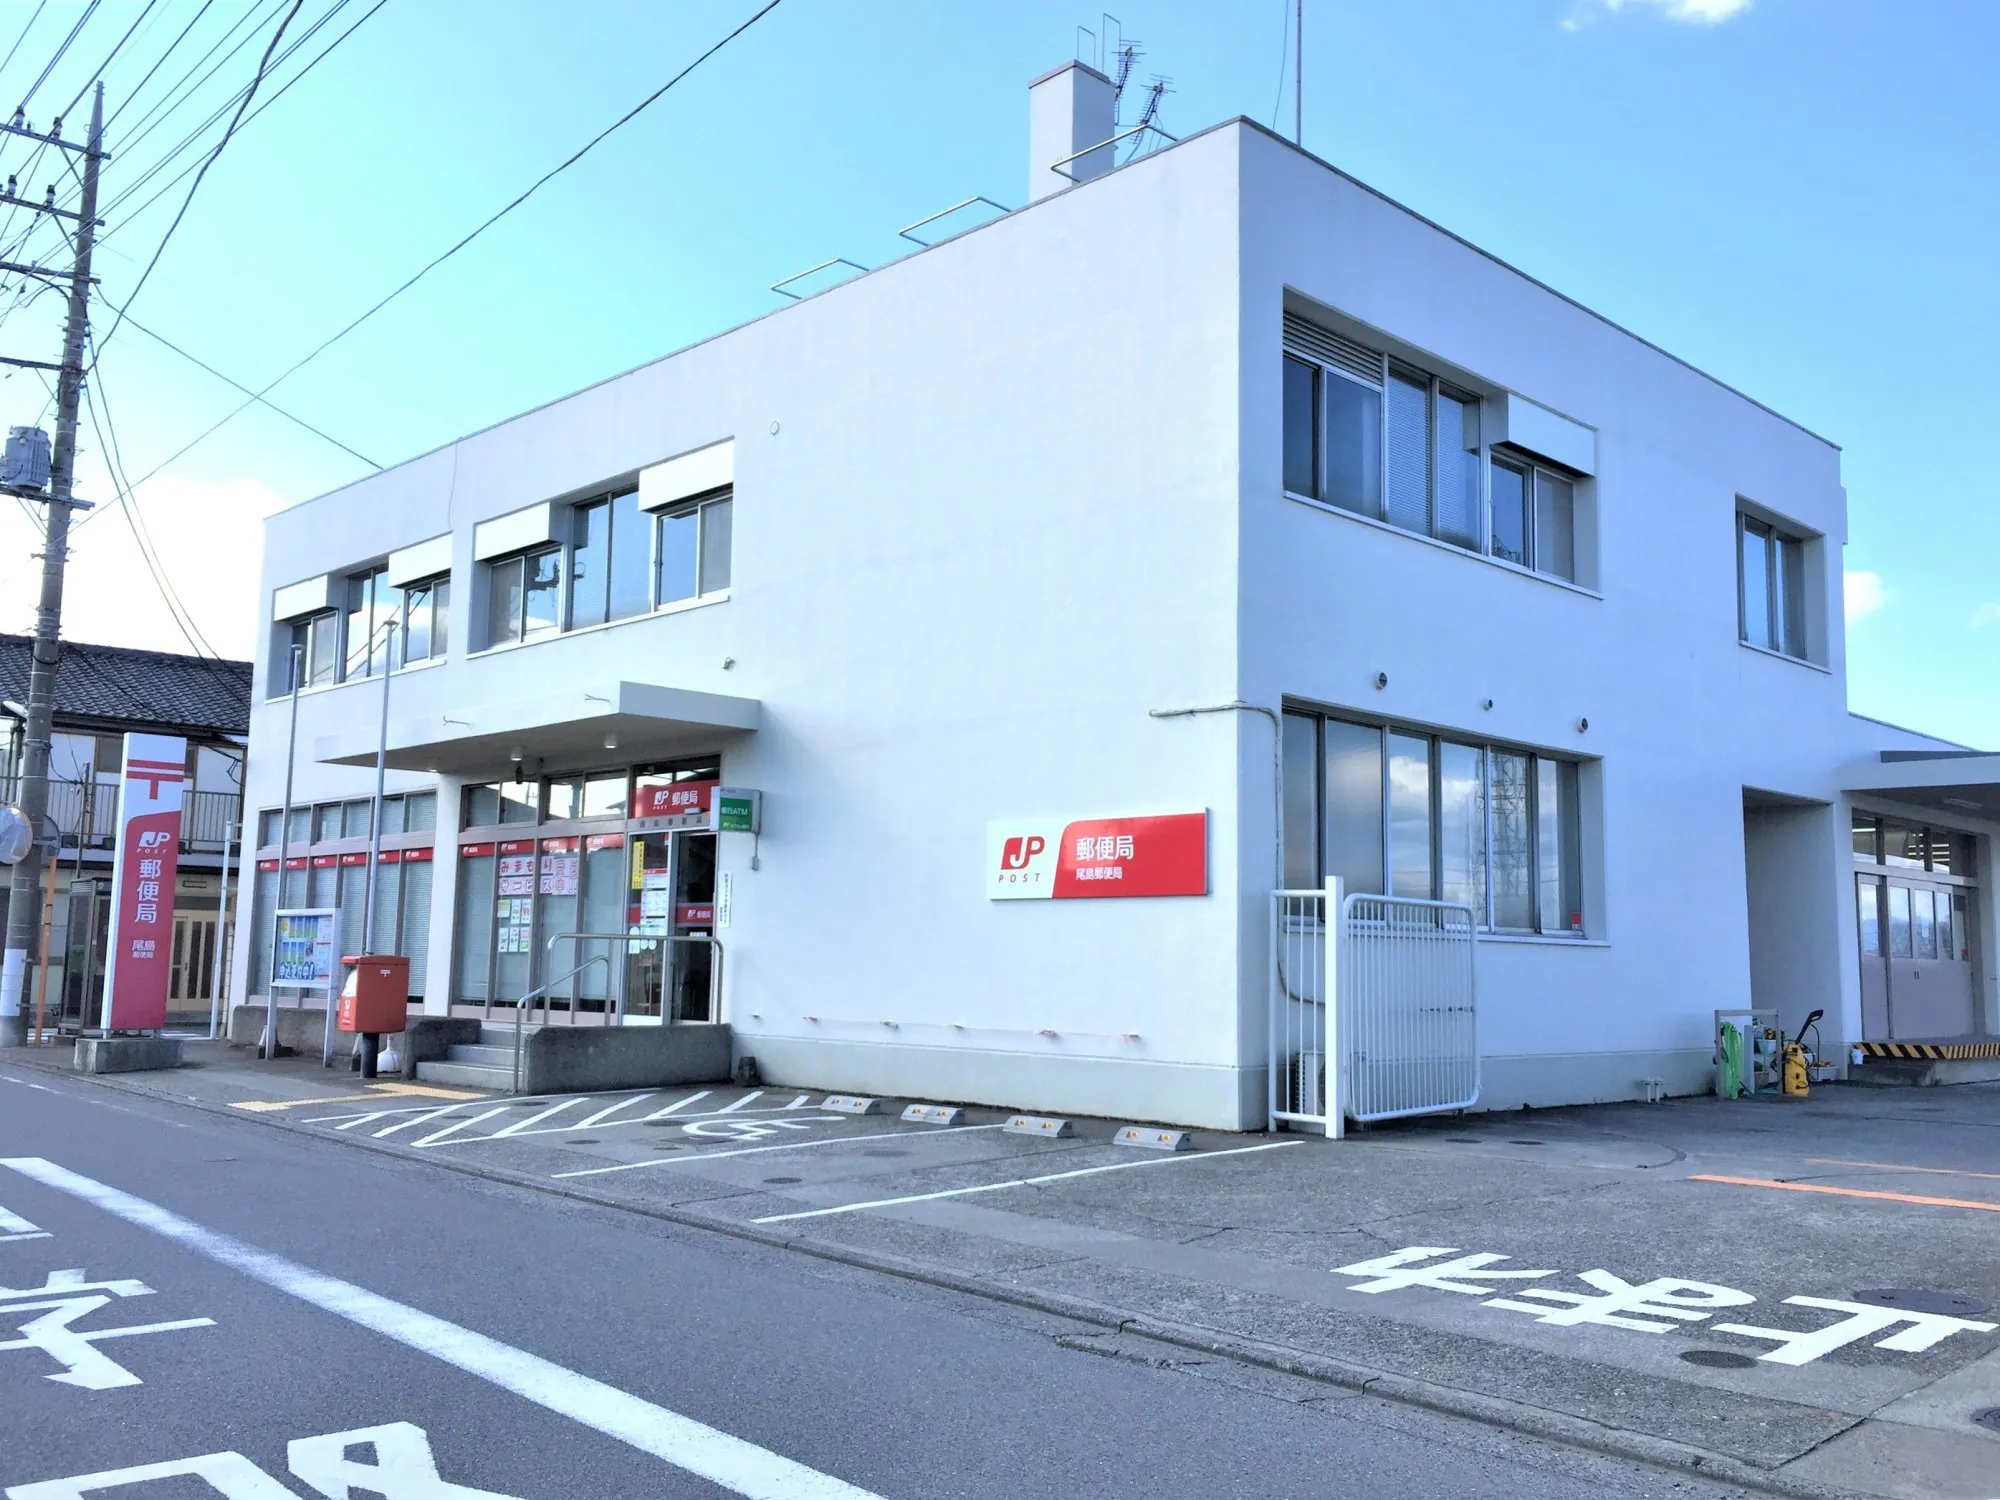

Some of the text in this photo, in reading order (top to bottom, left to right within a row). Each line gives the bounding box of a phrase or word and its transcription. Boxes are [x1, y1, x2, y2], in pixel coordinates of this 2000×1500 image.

[671, 790, 698, 806] 郵便局
[138, 831, 171, 848] JP
[1000, 836, 1045, 870] JP
[1076, 835, 1134, 861] 郵便局
[501, 858, 552, 873] みまもり
[1075, 866, 1123, 881] 尾島郵便局
[998, 872, 1041, 883] POST
[134, 858, 162, 924] 郵便局
[501, 878, 551, 894] サービス
[132, 940, 155, 952] 尾島
[133, 951, 154, 959] 郵便局
[1330, 1246, 1999, 1366] 止まれ
